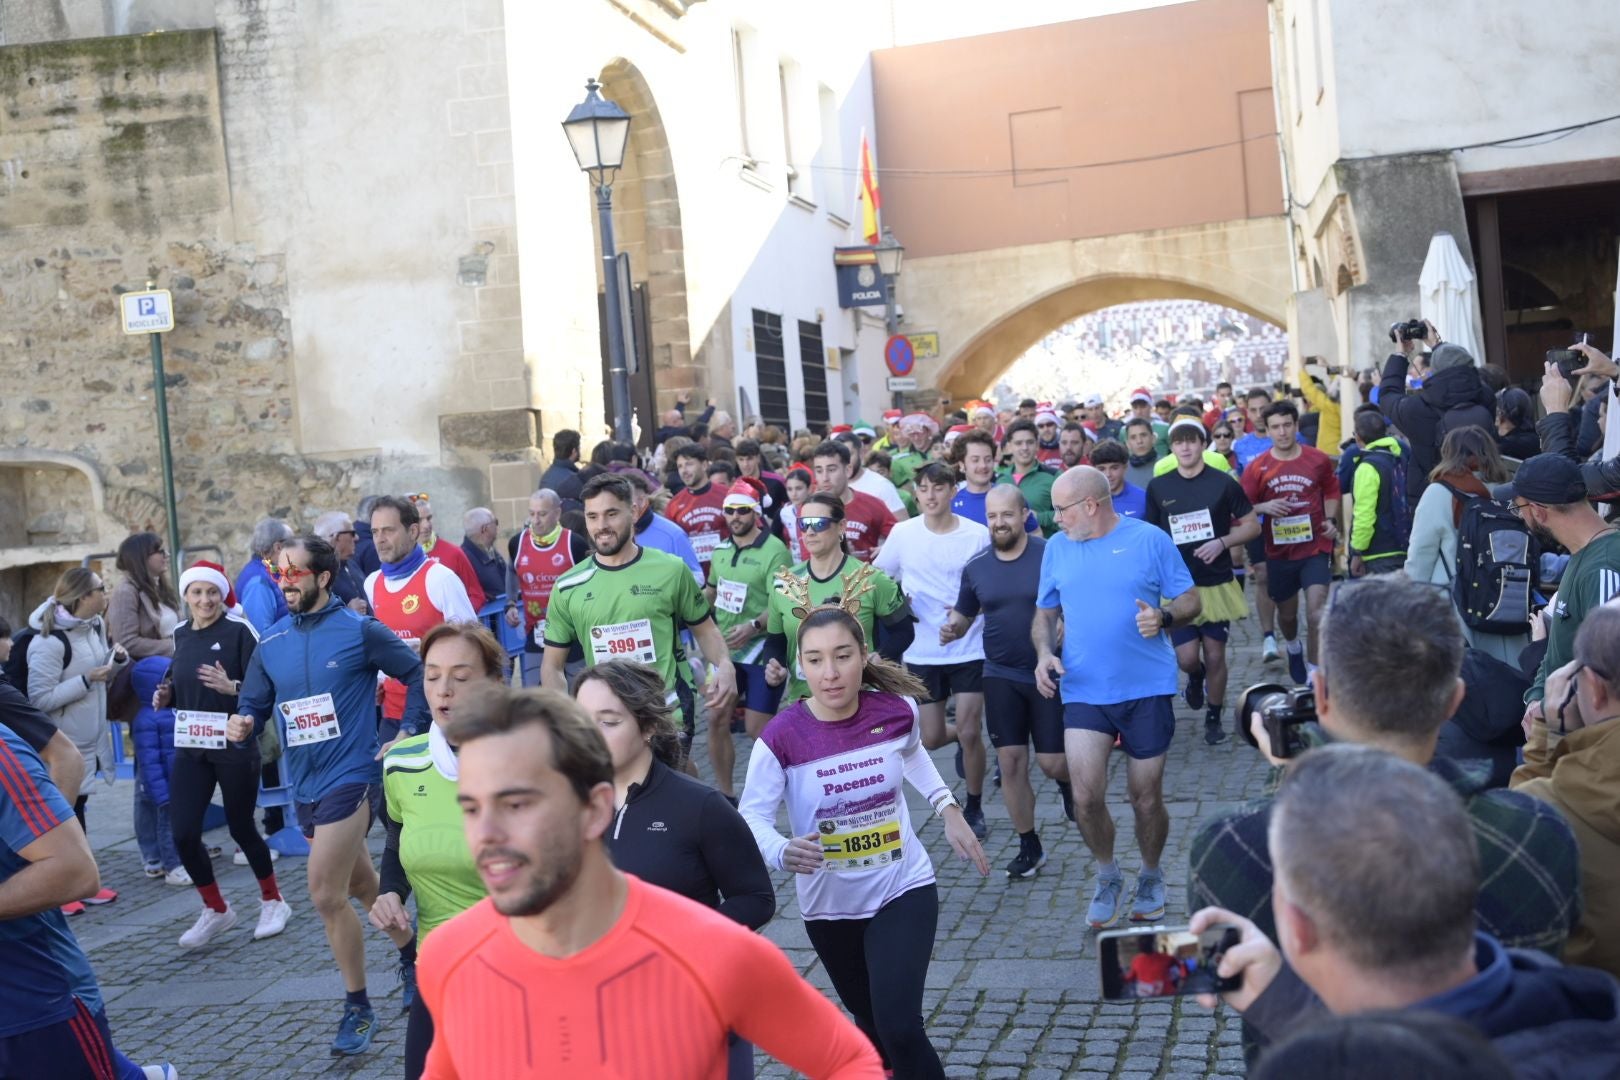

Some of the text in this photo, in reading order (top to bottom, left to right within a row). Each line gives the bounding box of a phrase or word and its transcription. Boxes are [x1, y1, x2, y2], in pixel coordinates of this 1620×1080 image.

[852, 290, 881, 300] POLICIA
[1280, 475, 1313, 487] SILVESTRE
[608, 637, 636, 654] 399
[188, 724, 213, 737] 1315
[294, 712, 320, 731] 1575
[816, 757, 884, 778] San Silvestre
[823, 773, 885, 796] Pacense
[843, 831, 882, 852] 1833
